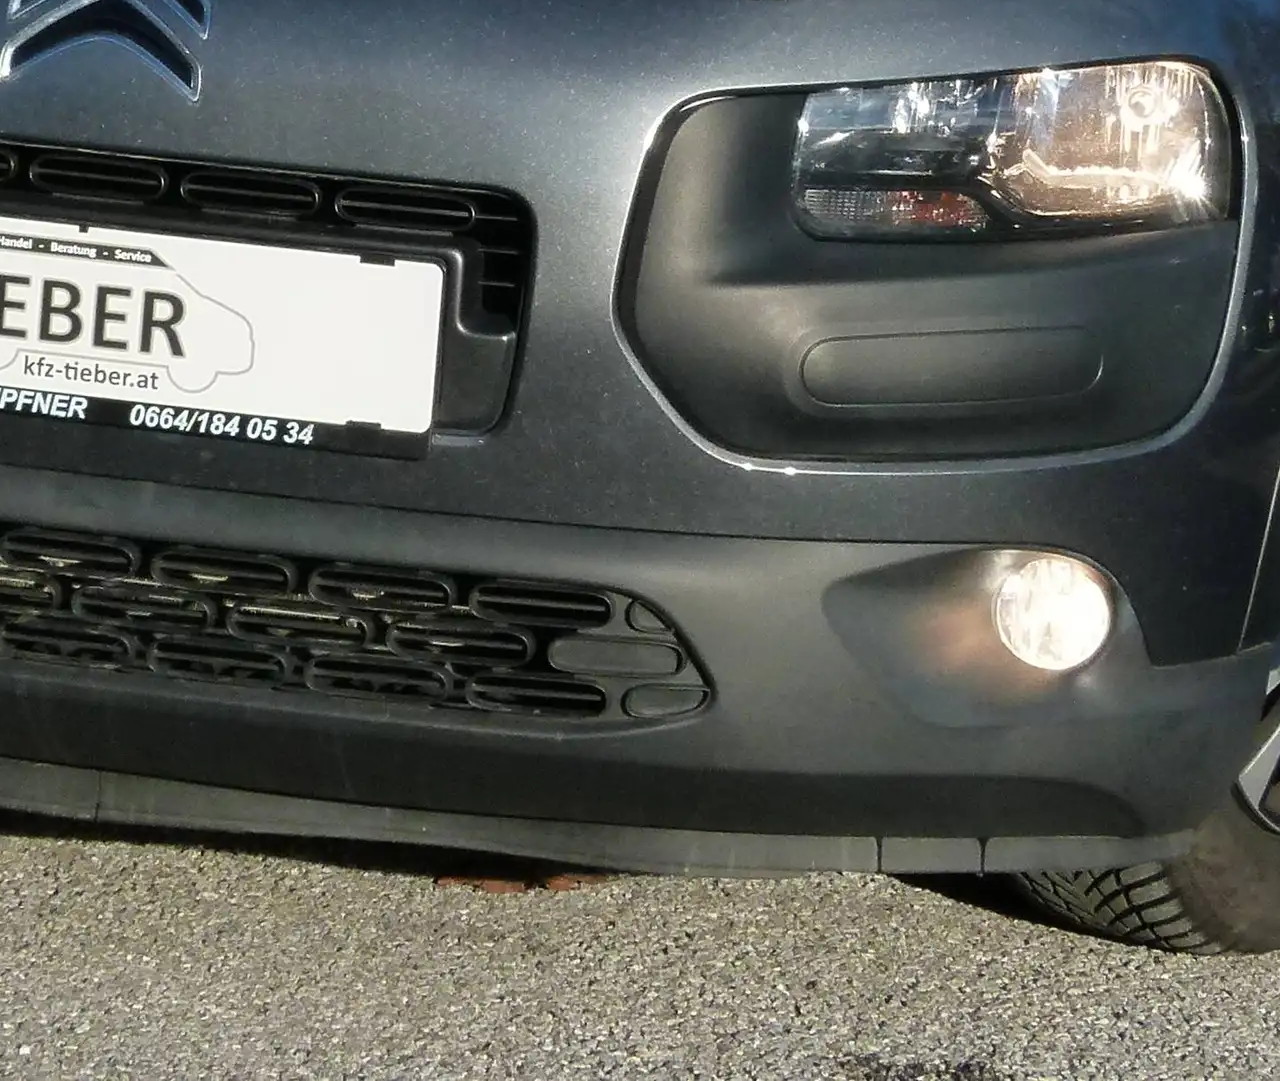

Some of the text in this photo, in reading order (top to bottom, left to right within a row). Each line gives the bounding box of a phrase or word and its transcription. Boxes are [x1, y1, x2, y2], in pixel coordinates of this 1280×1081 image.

[50, 242, 97, 258] Beratung
[114, 249, 152, 263] Service
[23, 355, 159, 390] kfz-tieber.at
[129, 404, 240, 437] 0664/184
[246, 417, 277, 441] 05
[283, 421, 315, 446] 34
